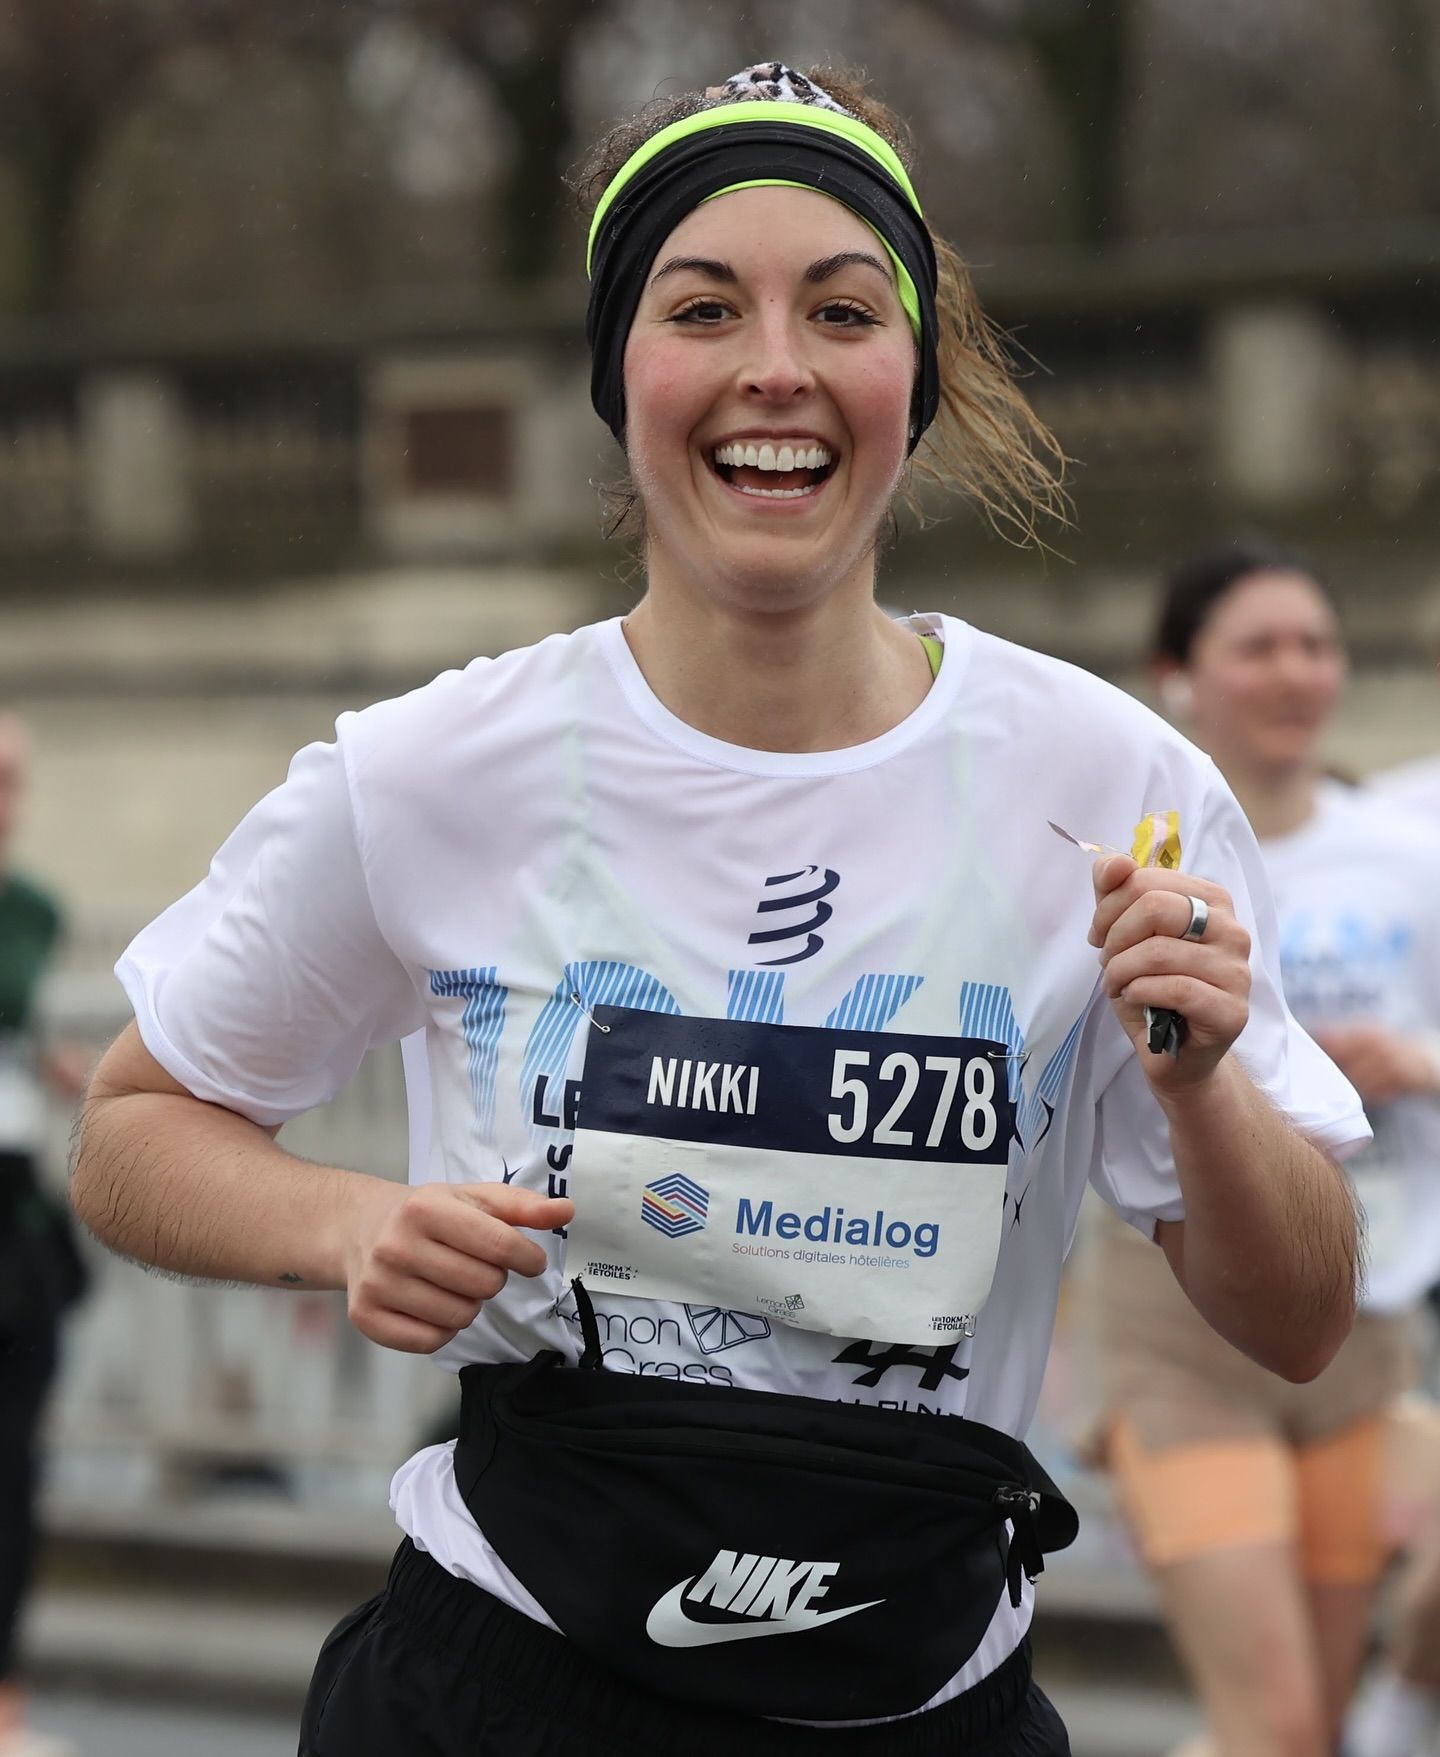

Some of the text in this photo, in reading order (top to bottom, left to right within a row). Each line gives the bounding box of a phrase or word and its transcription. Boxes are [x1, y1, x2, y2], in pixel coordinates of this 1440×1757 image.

[647, 1049, 998, 1151] NIKKI 5278
[735, 1198, 941, 1258] Medialog
[598, 1262, 623, 1273] 10KM
[731, 1242, 911, 1270] Solutions digitales hôtelières
[942, 1315, 963, 1324] 10KM
[686, 1549, 841, 1620] NIKE
